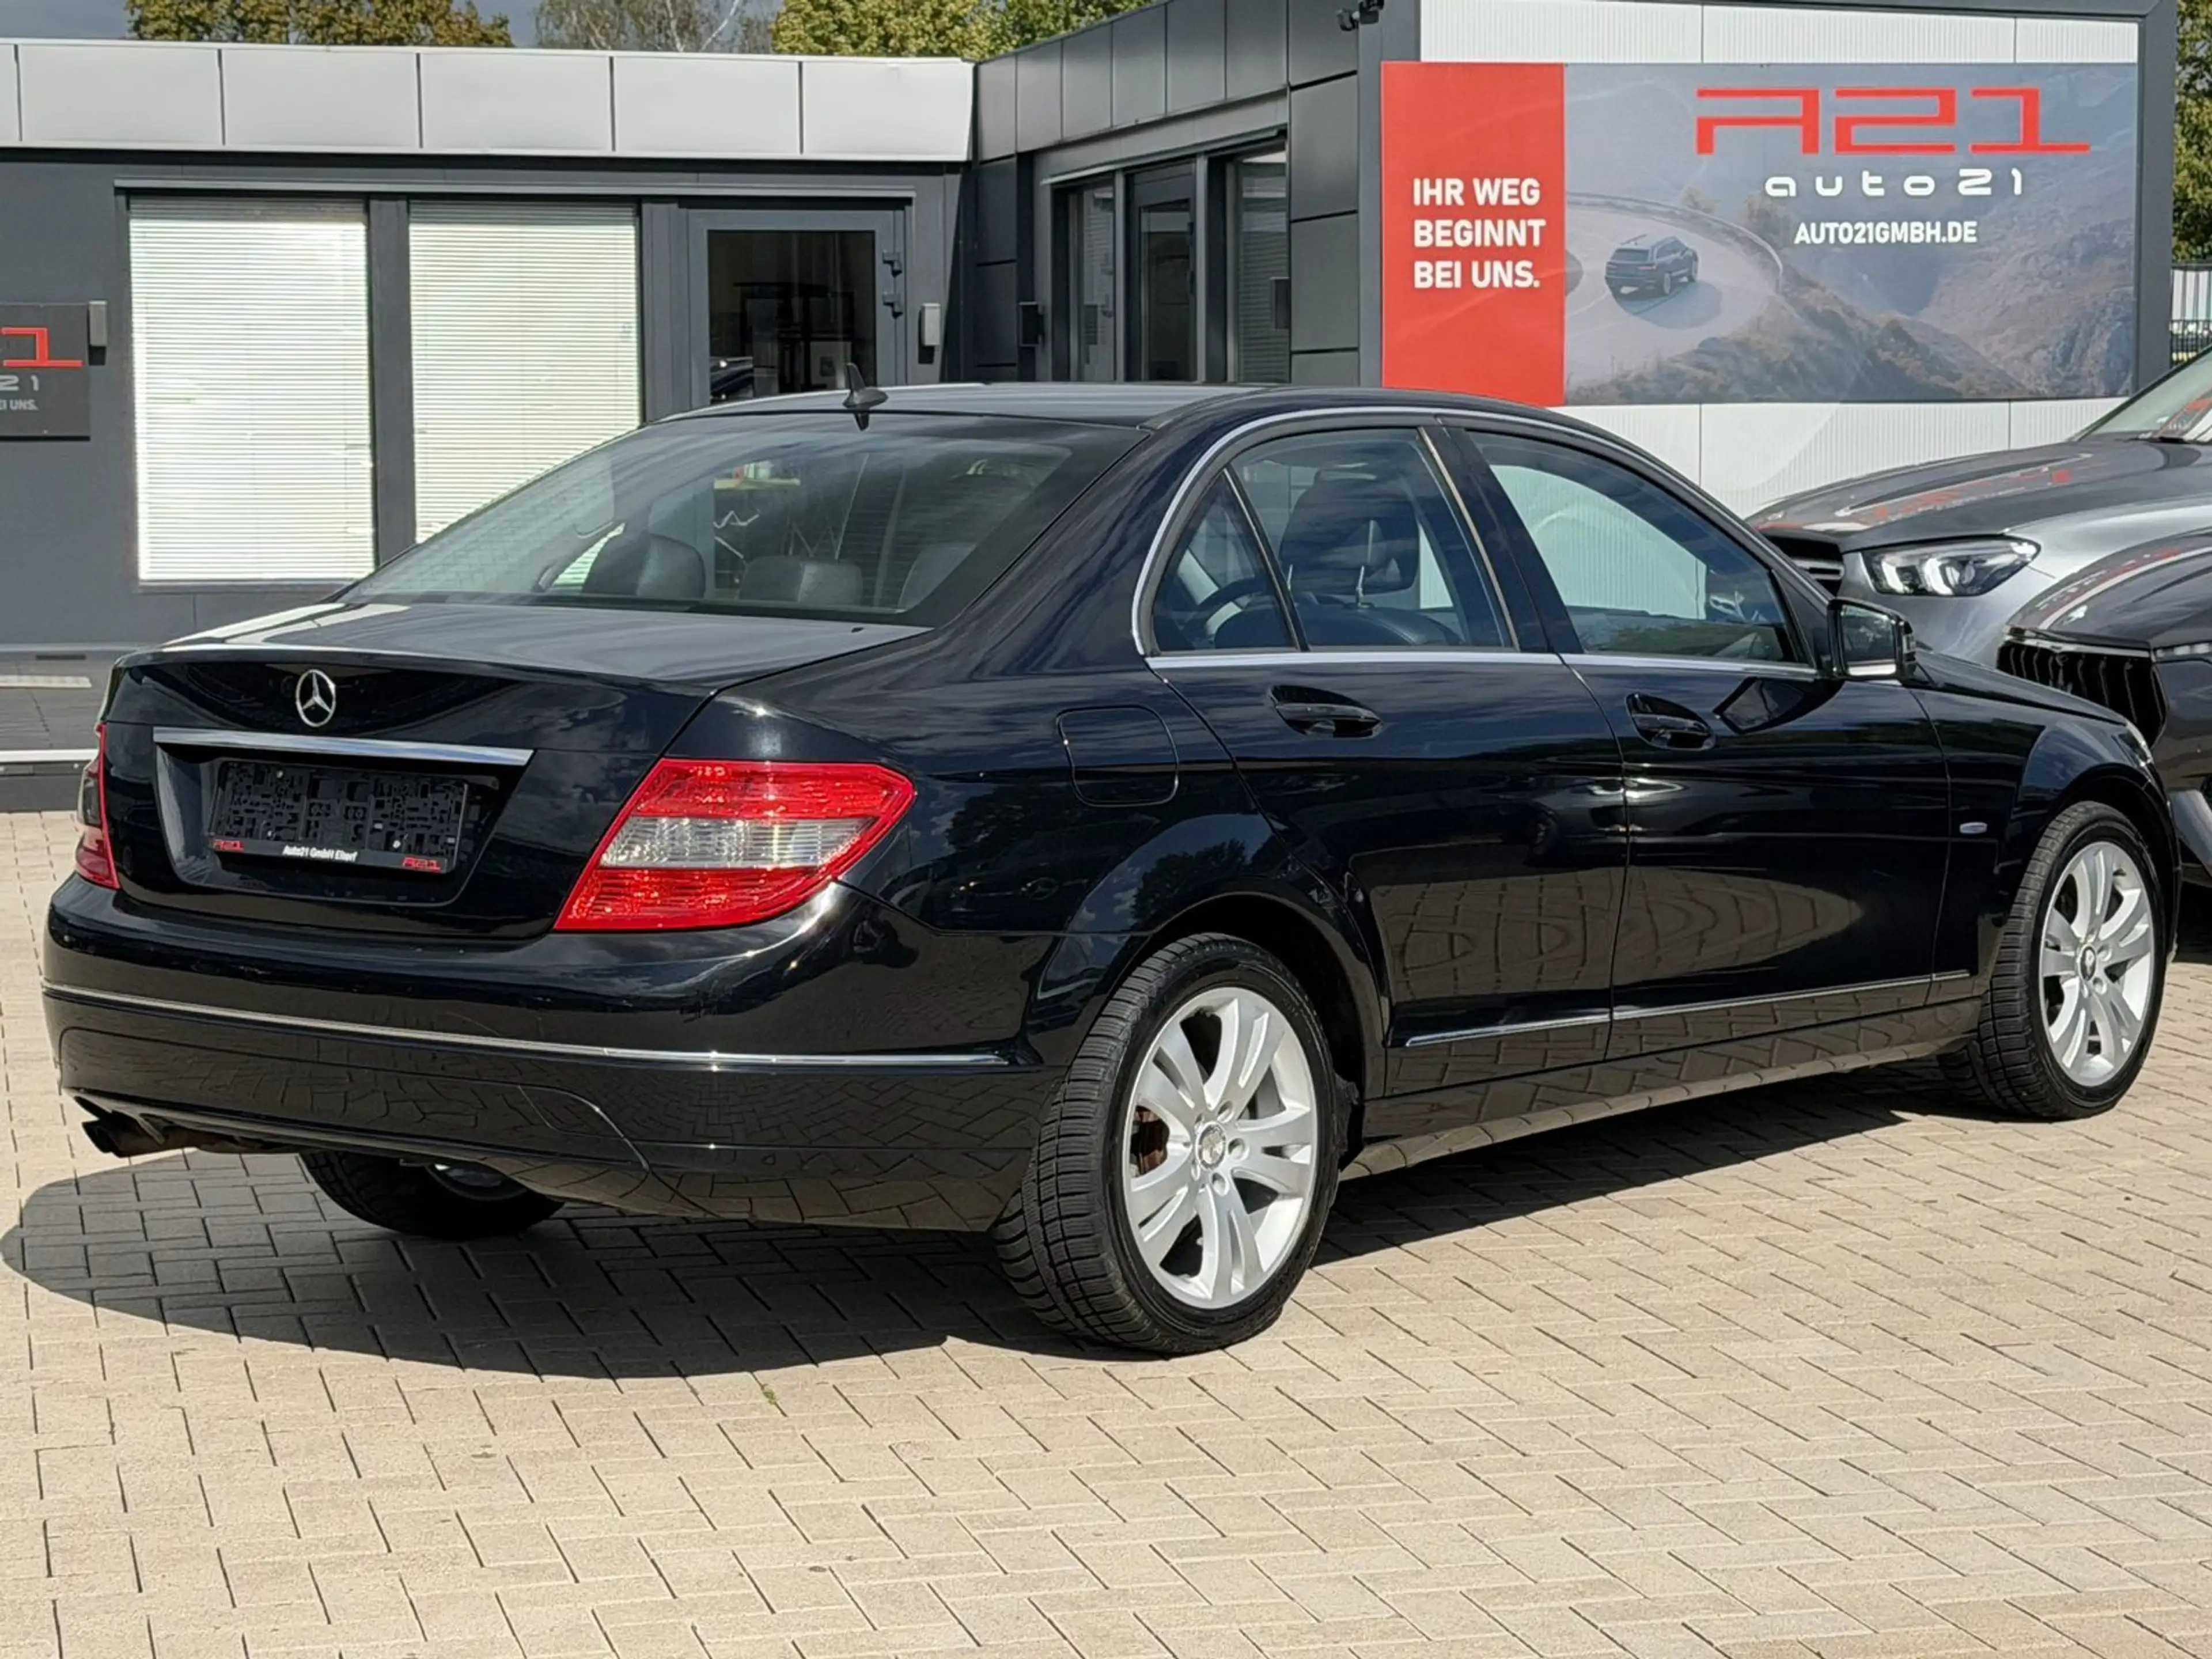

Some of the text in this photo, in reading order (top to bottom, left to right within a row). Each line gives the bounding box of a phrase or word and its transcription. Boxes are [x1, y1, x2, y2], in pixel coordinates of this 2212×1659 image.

[1695, 87, 2090, 155] A21
[1413, 177, 1540, 206] IHR WEG
[1414, 219, 1547, 248] BEGINNT
[1794, 221, 1978, 244] AUTO21GMBH.DE
[1414, 260, 1540, 289] BEI UNS.
[309, 847, 335, 859] GmbH
